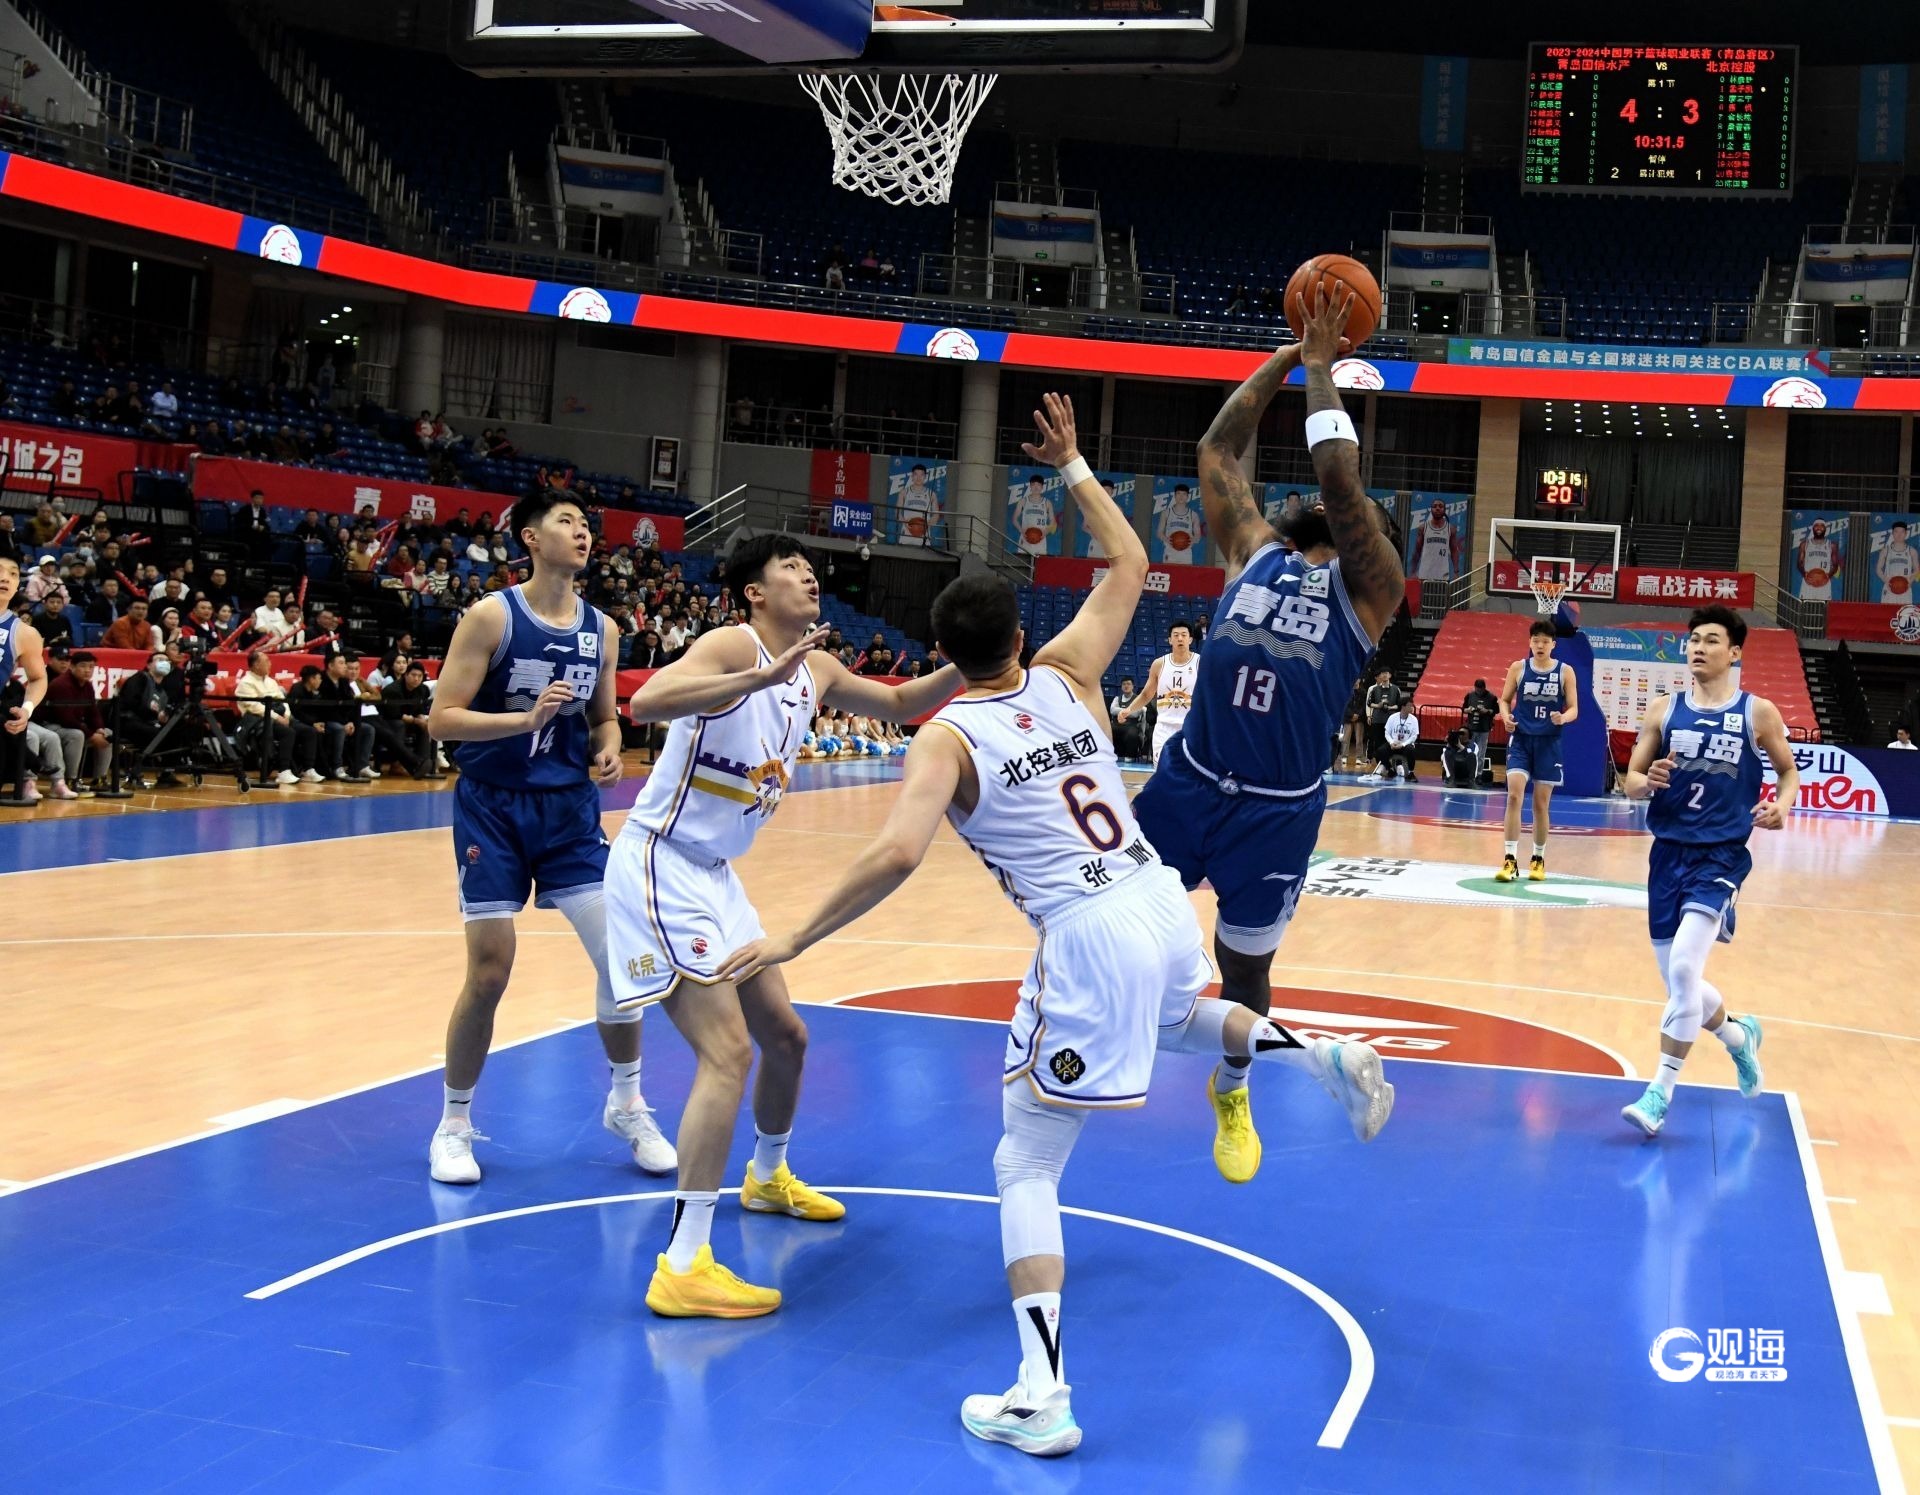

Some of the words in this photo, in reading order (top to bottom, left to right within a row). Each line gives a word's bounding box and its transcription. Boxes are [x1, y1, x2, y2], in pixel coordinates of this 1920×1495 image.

[1557, 59, 1631, 71] 青岛国信水产
[1656, 62, 1668, 70] VS
[1706, 62, 1756, 73] 北京控股
[1620, 99, 1638, 123] 4
[1682, 99, 1699, 124] 3
[1635, 135, 1684, 148] 10:31.5
[1611, 167, 1619, 178] 2
[1696, 169, 1701, 180] 1
[1547, 486, 1571, 503] 20
[849, 510, 872, 520] 安全出口
[1636, 575, 1738, 599] 赢战未来
[1225, 583, 1330, 643] 青岛
[505, 657, 598, 700] 青岛
[1173, 676, 1182, 688] 14
[1233, 665, 1276, 713] 13
[1523, 682, 1558, 696] 青岛
[1535, 706, 1547, 719] 15
[529, 726, 556, 758] 14
[1670, 729, 1743, 765] 青岛
[1000, 729, 1098, 788] 北控集团
[1761, 749, 1845, 774] 岁山
[1688, 783, 1704, 809] 2
[1760, 775, 1875, 812] nten
[1060, 774, 1124, 853] 6
[628, 953, 662, 979] 北京
